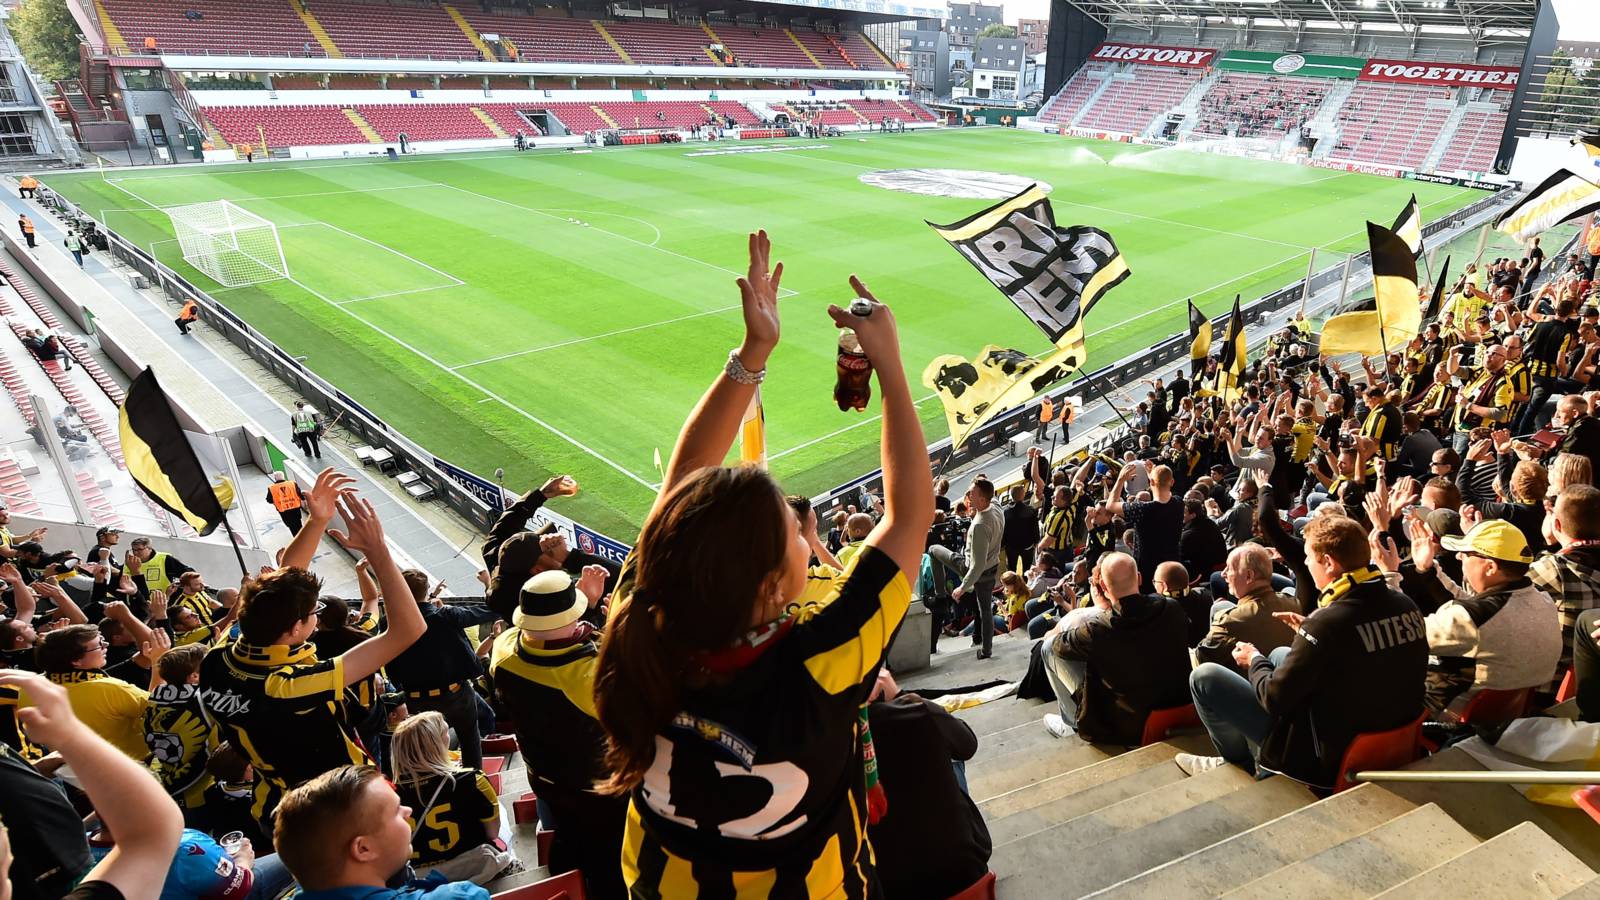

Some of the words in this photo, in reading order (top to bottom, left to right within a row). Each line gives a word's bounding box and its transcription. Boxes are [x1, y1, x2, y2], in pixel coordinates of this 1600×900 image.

[1094, 45, 1213, 65] HISTORY
[1360, 164, 1395, 177] UniCredit
[452, 474, 500, 507] RESPECT
[1355, 609, 1425, 653] VITESS
[720, 732, 756, 766] HEM
